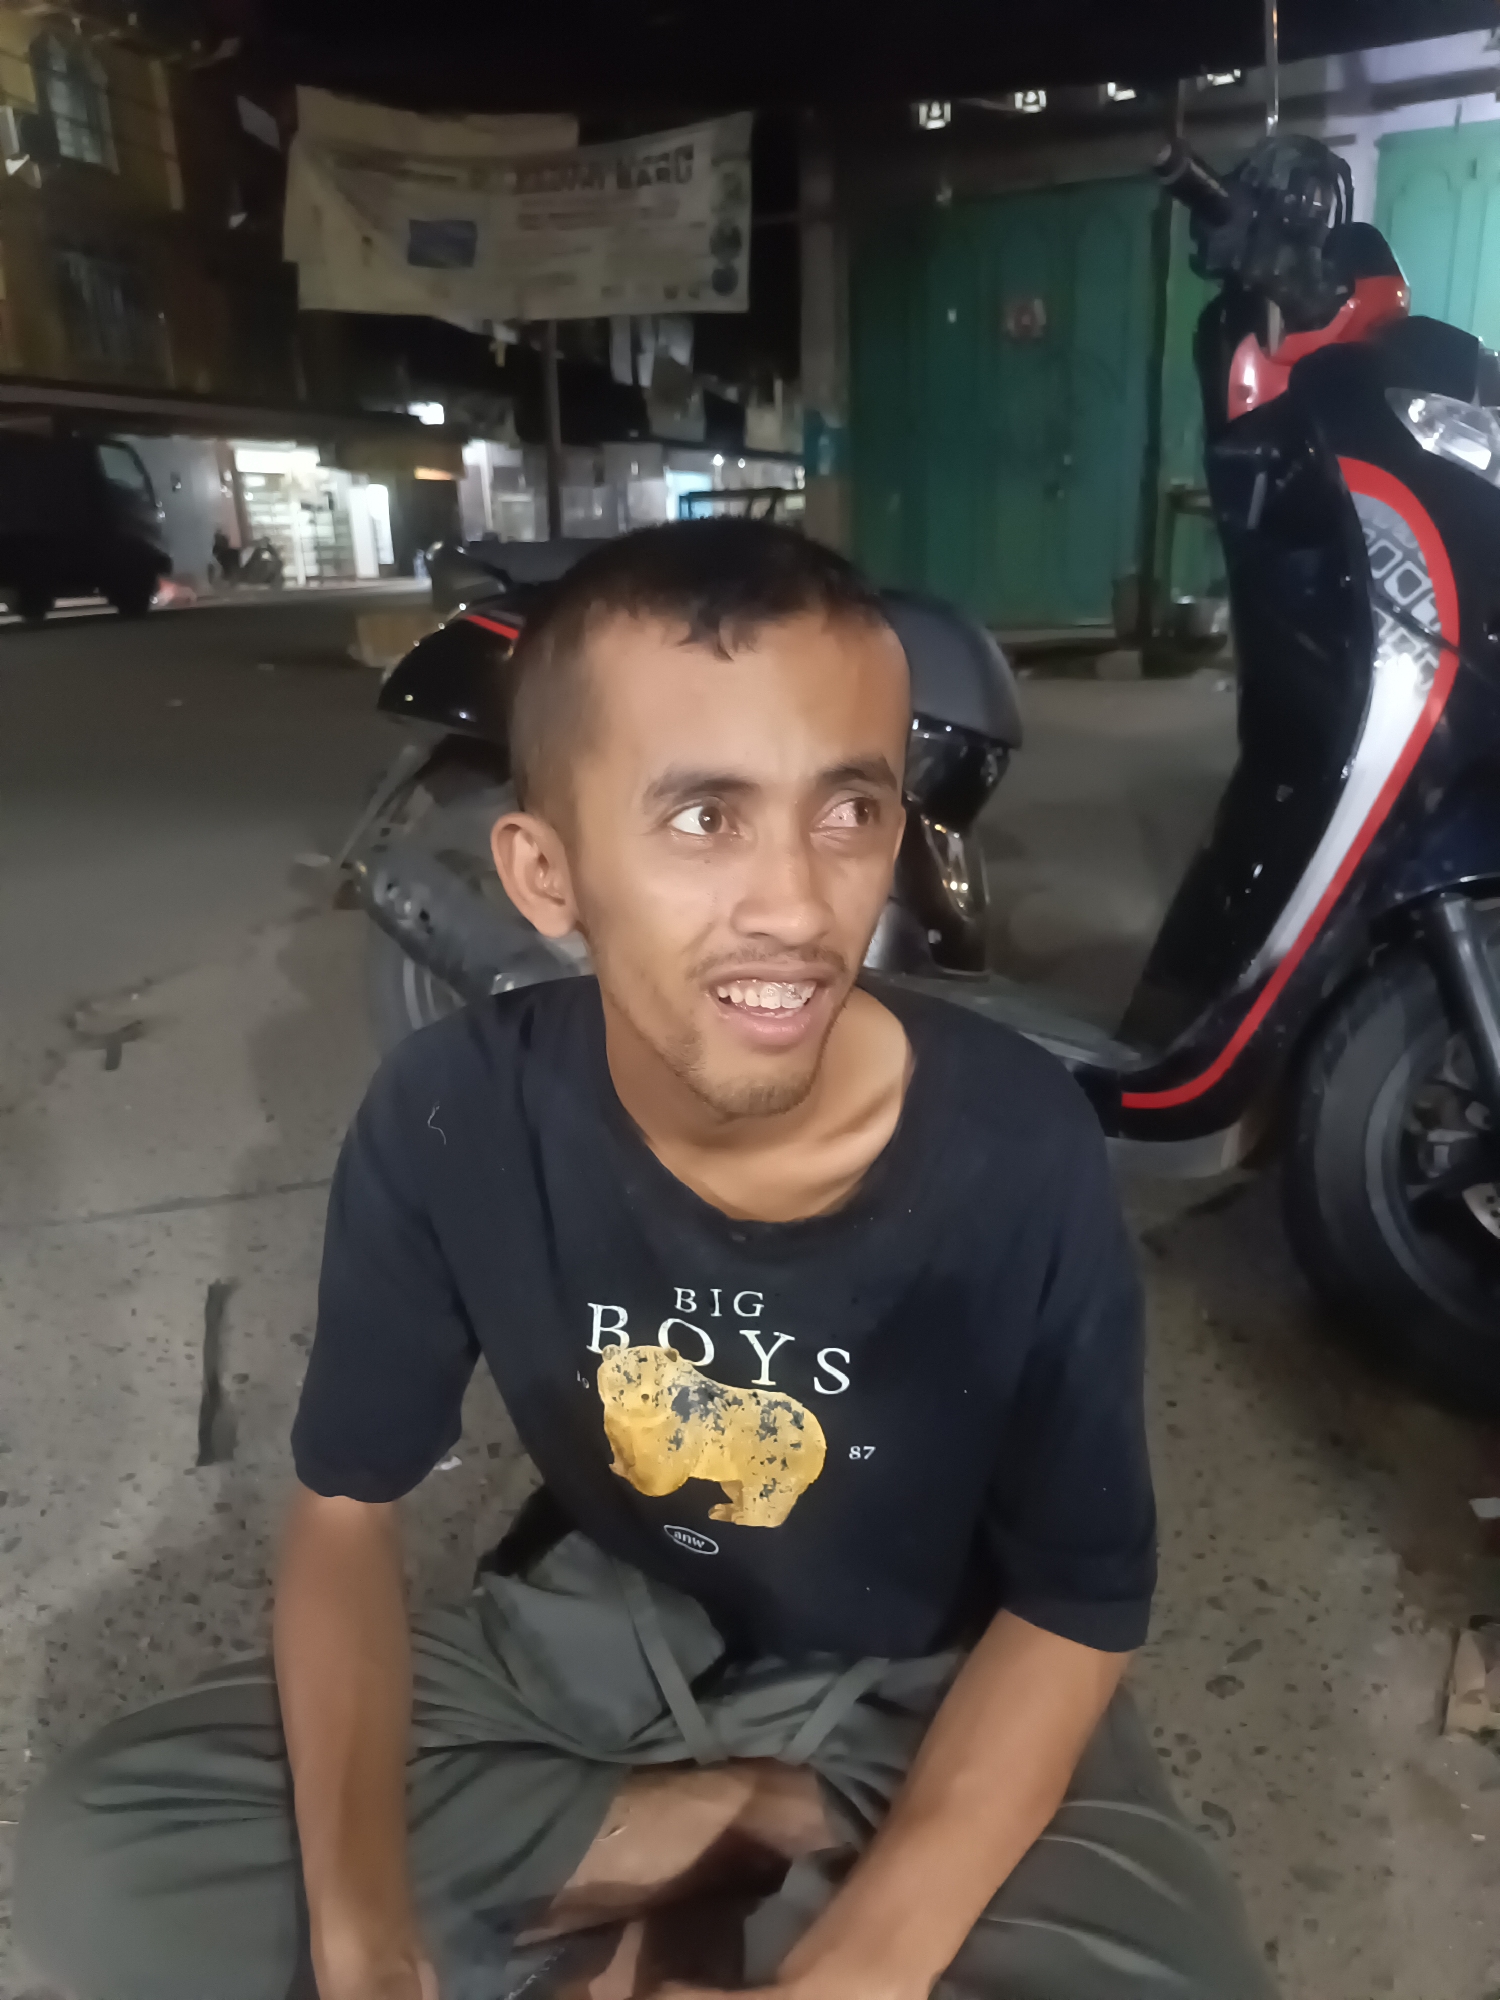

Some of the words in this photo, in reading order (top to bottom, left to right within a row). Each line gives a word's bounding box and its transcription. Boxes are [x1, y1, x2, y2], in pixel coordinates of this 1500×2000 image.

[674, 1287, 765, 1317] BIG
[587, 1302, 850, 1395] BOYS
[848, 1446, 876, 1460] 87
